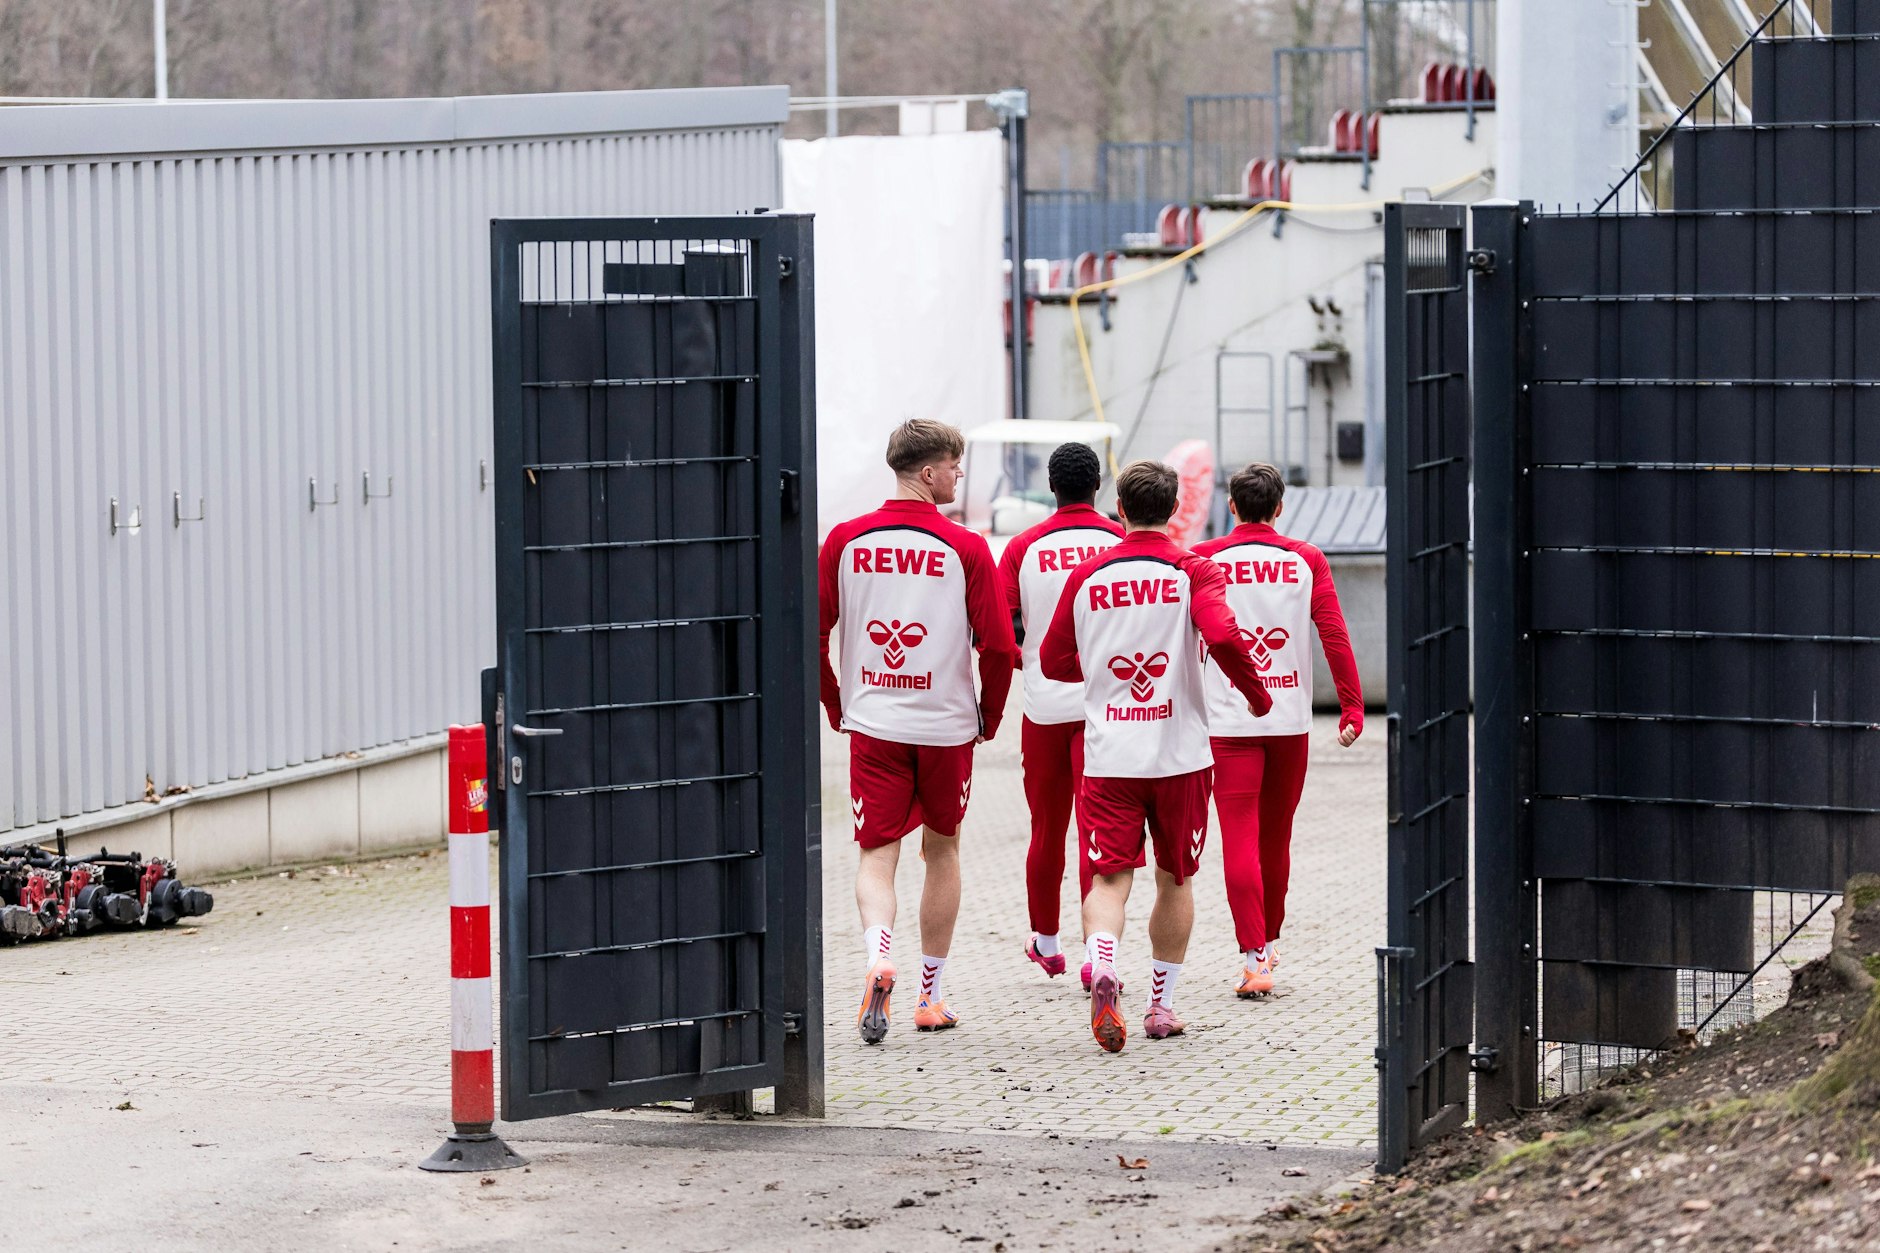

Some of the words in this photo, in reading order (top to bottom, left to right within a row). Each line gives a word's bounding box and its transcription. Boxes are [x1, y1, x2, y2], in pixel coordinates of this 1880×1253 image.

[853, 547, 946, 578] REWE
[1038, 545, 1112, 573] REW
[1088, 578, 1181, 612] REWE
[861, 665, 932, 690] hummel
[1106, 698, 1173, 722] hummel
